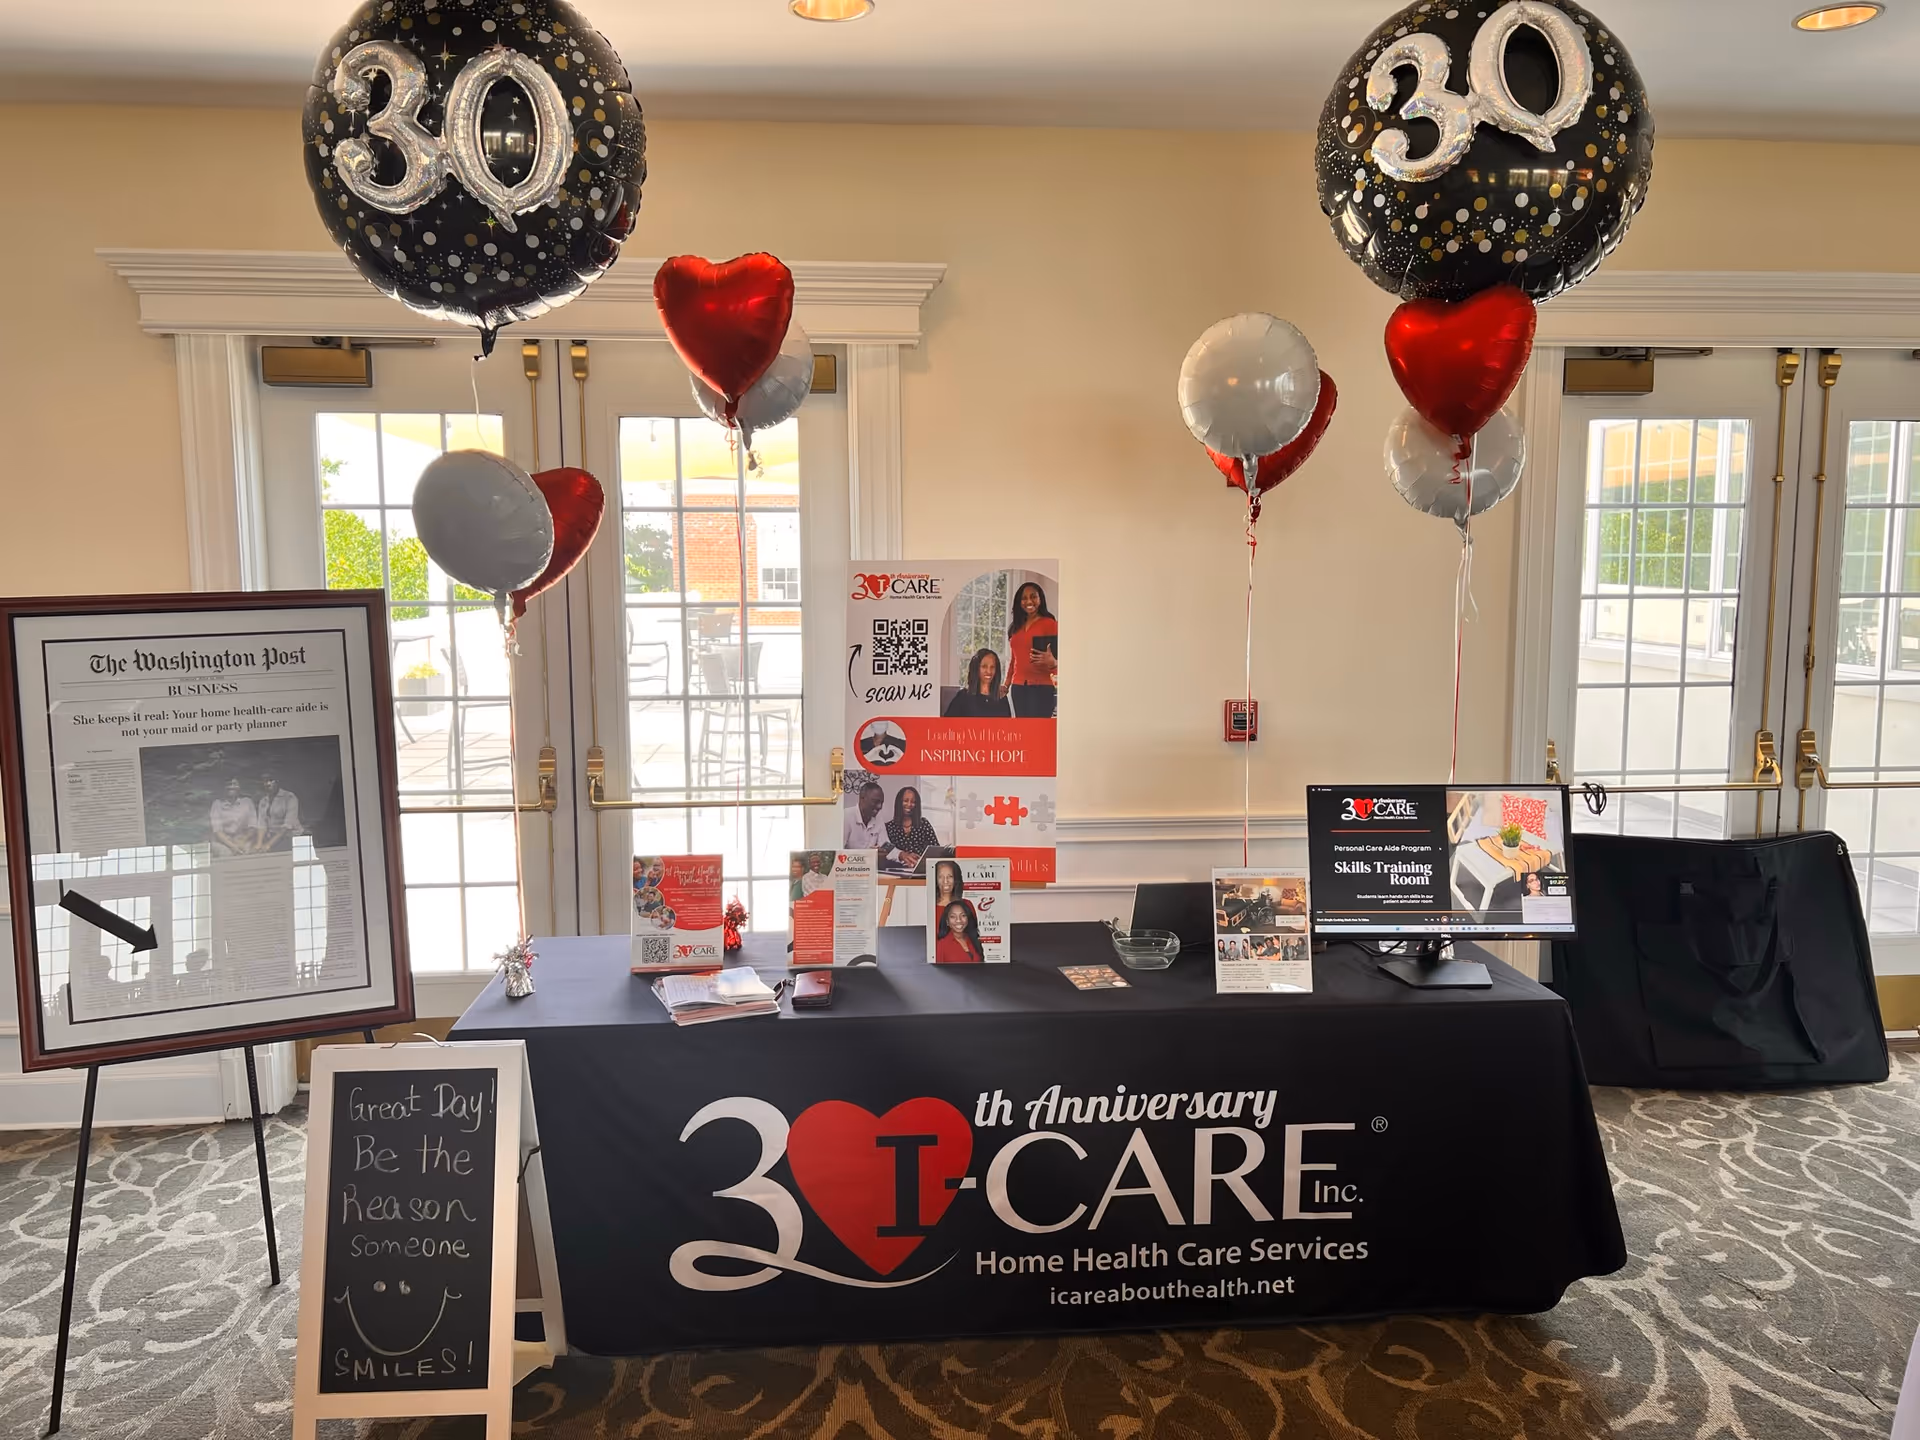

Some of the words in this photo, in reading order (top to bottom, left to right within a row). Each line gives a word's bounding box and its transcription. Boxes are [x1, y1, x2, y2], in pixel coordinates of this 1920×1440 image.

[1366, 1, 1594, 183] 30
[333, 40, 574, 217] 30
[90, 653, 128, 676] The
[133, 649, 256, 673] Washington
[262, 646, 306, 671] Post
[168, 682, 239, 696] BUSINESS
[865, 686, 906, 703] SCAN
[908, 683, 932, 701] ME
[73, 714, 96, 726] She
[97, 713, 131, 725] keeps
[133, 711, 142, 723] it
[144, 710, 170, 722] real:
[172, 708, 198, 720] Your
[200, 707, 231, 719] home
[233, 704, 293, 717] health-care
[295, 702, 318, 713] aide
[320, 701, 329, 711] is
[1232, 702, 1255, 712] FIRE
[121, 727, 140, 738] not
[143, 727, 168, 739] your
[171, 723, 198, 735] maid
[201, 724, 213, 733] or
[216, 721, 243, 734] party
[246, 718, 288, 731] planner
[920, 749, 986, 763] INSPIRING
[990, 749, 1027, 763] HOPE
[1401, 845, 1432, 853] Program
[1334, 861, 1372, 874] Skills
[1373, 861, 1433, 876] Training
[1390, 873, 1430, 886] Room
[978, 897, 995, 911] &
[349, 1084, 422, 1122] Great
[432, 1078, 495, 1132] Day!
[975, 1088, 1014, 1127] th
[1025, 1084, 1278, 1131] Anniversary
[353, 1134, 400, 1173] Be
[414, 1134, 474, 1176] the
[342, 1184, 476, 1225] Reason
[1313, 1178, 1365, 1205] Inc.
[976, 1250, 1063, 1275] Home
[1073, 1245, 1169, 1271] Health
[1177, 1242, 1242, 1267] Care
[1250, 1237, 1370, 1263] Services
[1050, 1276, 1296, 1305] icareabouthealth.net
